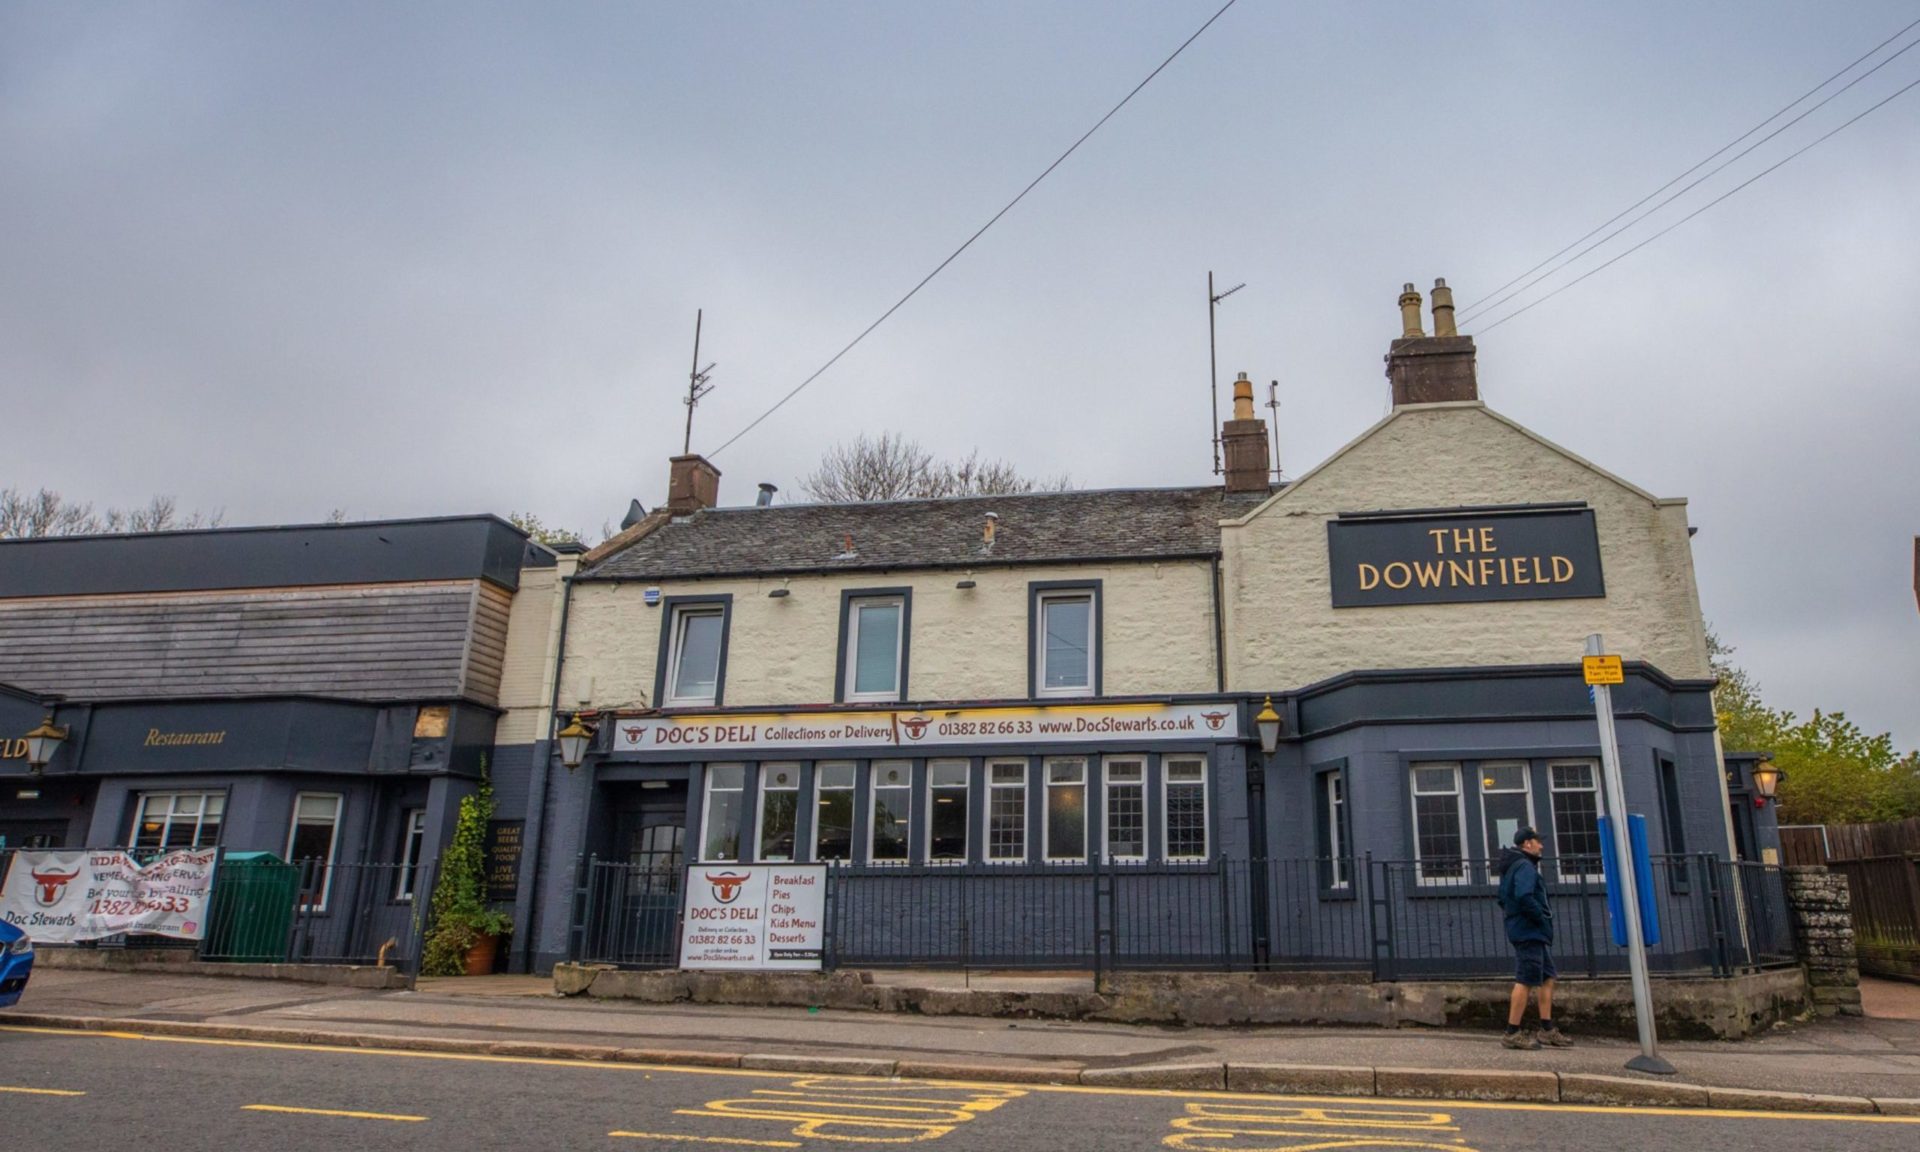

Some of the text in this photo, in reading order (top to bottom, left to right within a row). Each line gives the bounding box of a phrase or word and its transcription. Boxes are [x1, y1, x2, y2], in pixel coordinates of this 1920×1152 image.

[1429, 527, 1497, 554] THE
[1358, 556, 1574, 590] DOWNFIELD
[939, 715, 1195, 736] 01382 82 66 33 www.DocStewarts.co.uk
[144, 728, 226, 746] Restaurant
[656, 724, 893, 744] DOC'S DELI Collections or Delivery
[774, 875, 815, 885] Breakfast
[772, 889, 790, 899] Pies
[691, 907, 758, 920] DOC'S DELI
[771, 904, 796, 916] Chips
[6, 911, 76, 927] Doc Stewarts
[770, 919, 816, 929] Kids Menu
[688, 935, 756, 944] 01382 82 66 33
[769, 933, 806, 943] Desserts
